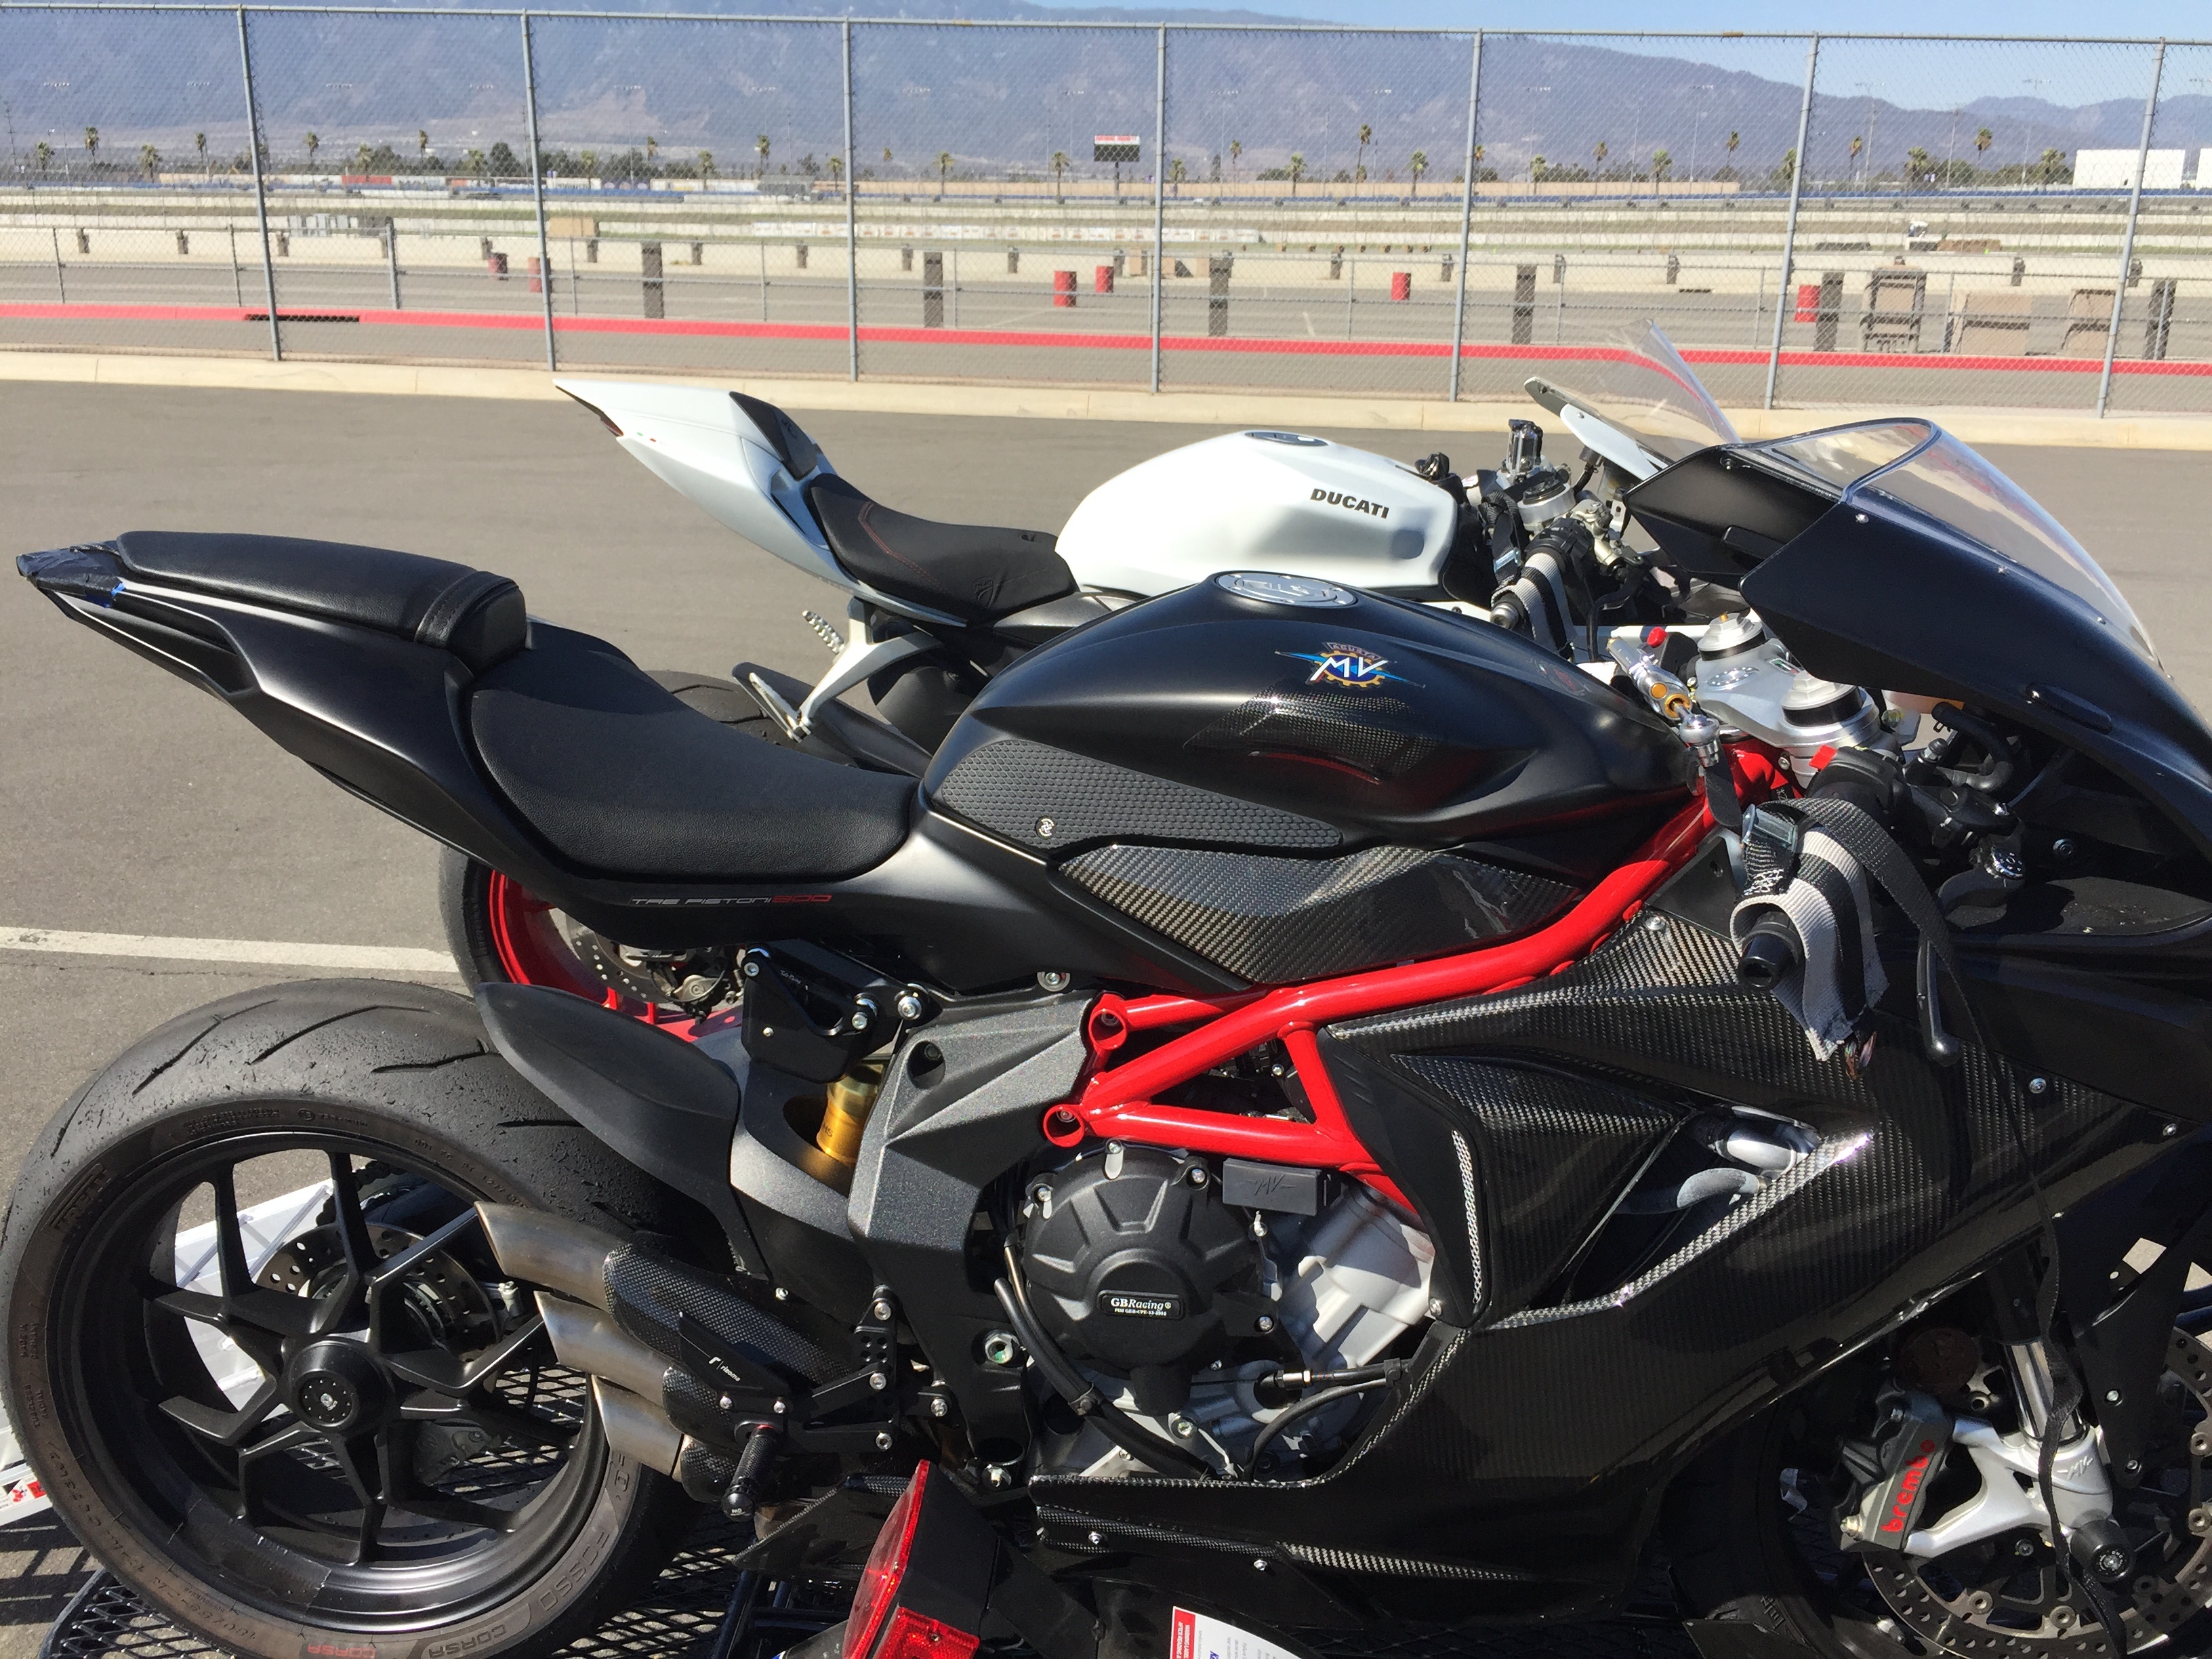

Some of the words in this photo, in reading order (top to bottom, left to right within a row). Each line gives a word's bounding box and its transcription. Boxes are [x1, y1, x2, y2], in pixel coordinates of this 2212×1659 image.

[1310, 488, 1390, 519] DUCATI
[1309, 656, 1389, 682] MV
[1880, 1439, 1936, 1532] brembo
[307, 1644, 376, 1658] CORSA
[428, 1625, 508, 1658] CORSA
